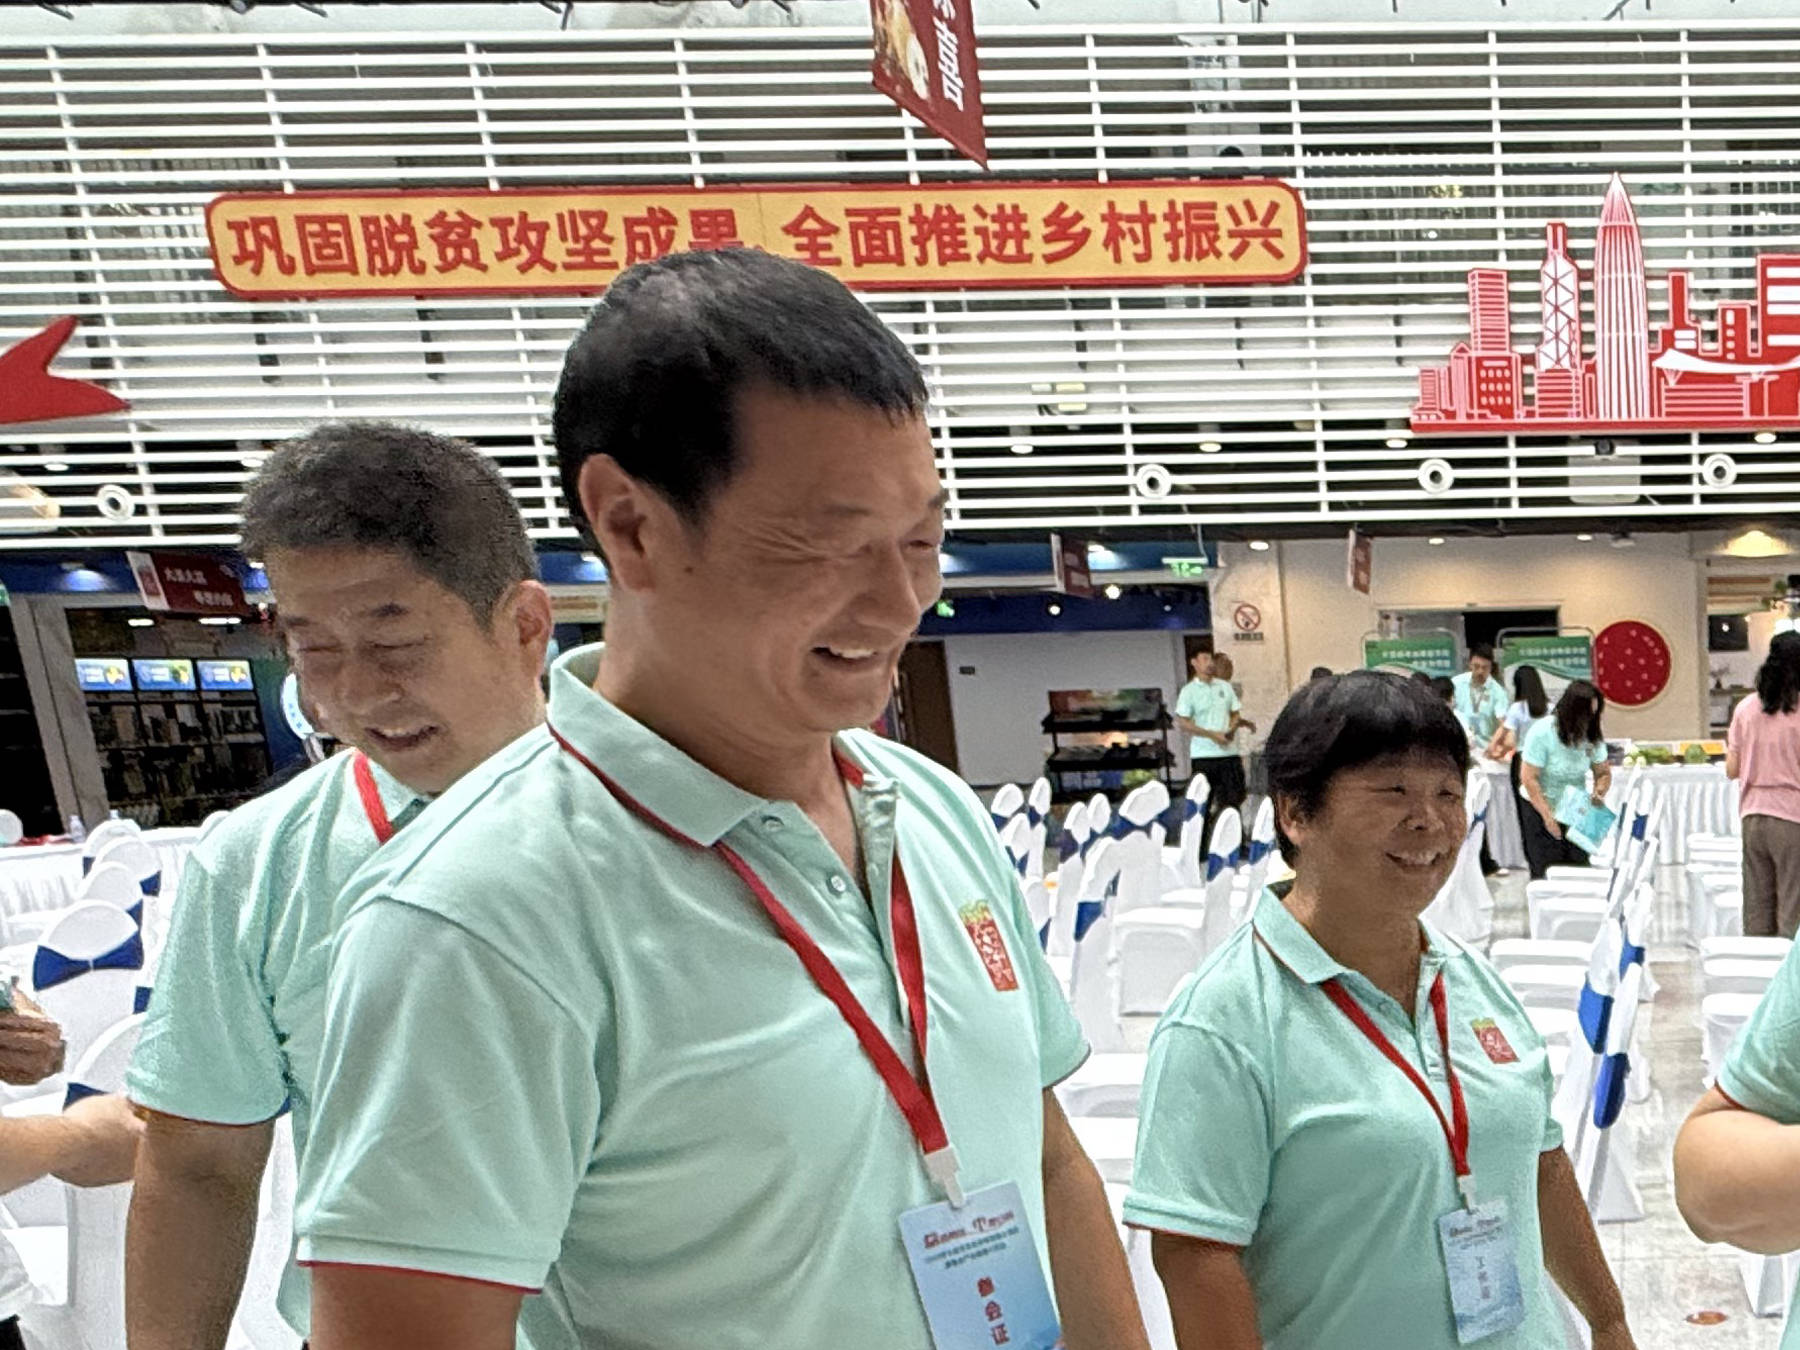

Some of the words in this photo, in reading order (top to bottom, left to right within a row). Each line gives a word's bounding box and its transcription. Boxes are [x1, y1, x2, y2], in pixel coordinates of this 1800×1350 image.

[226, 205, 745, 277] 巩固脱贫攻坚成果
[780, 199, 1284, 267] 全面推进乡村振兴
